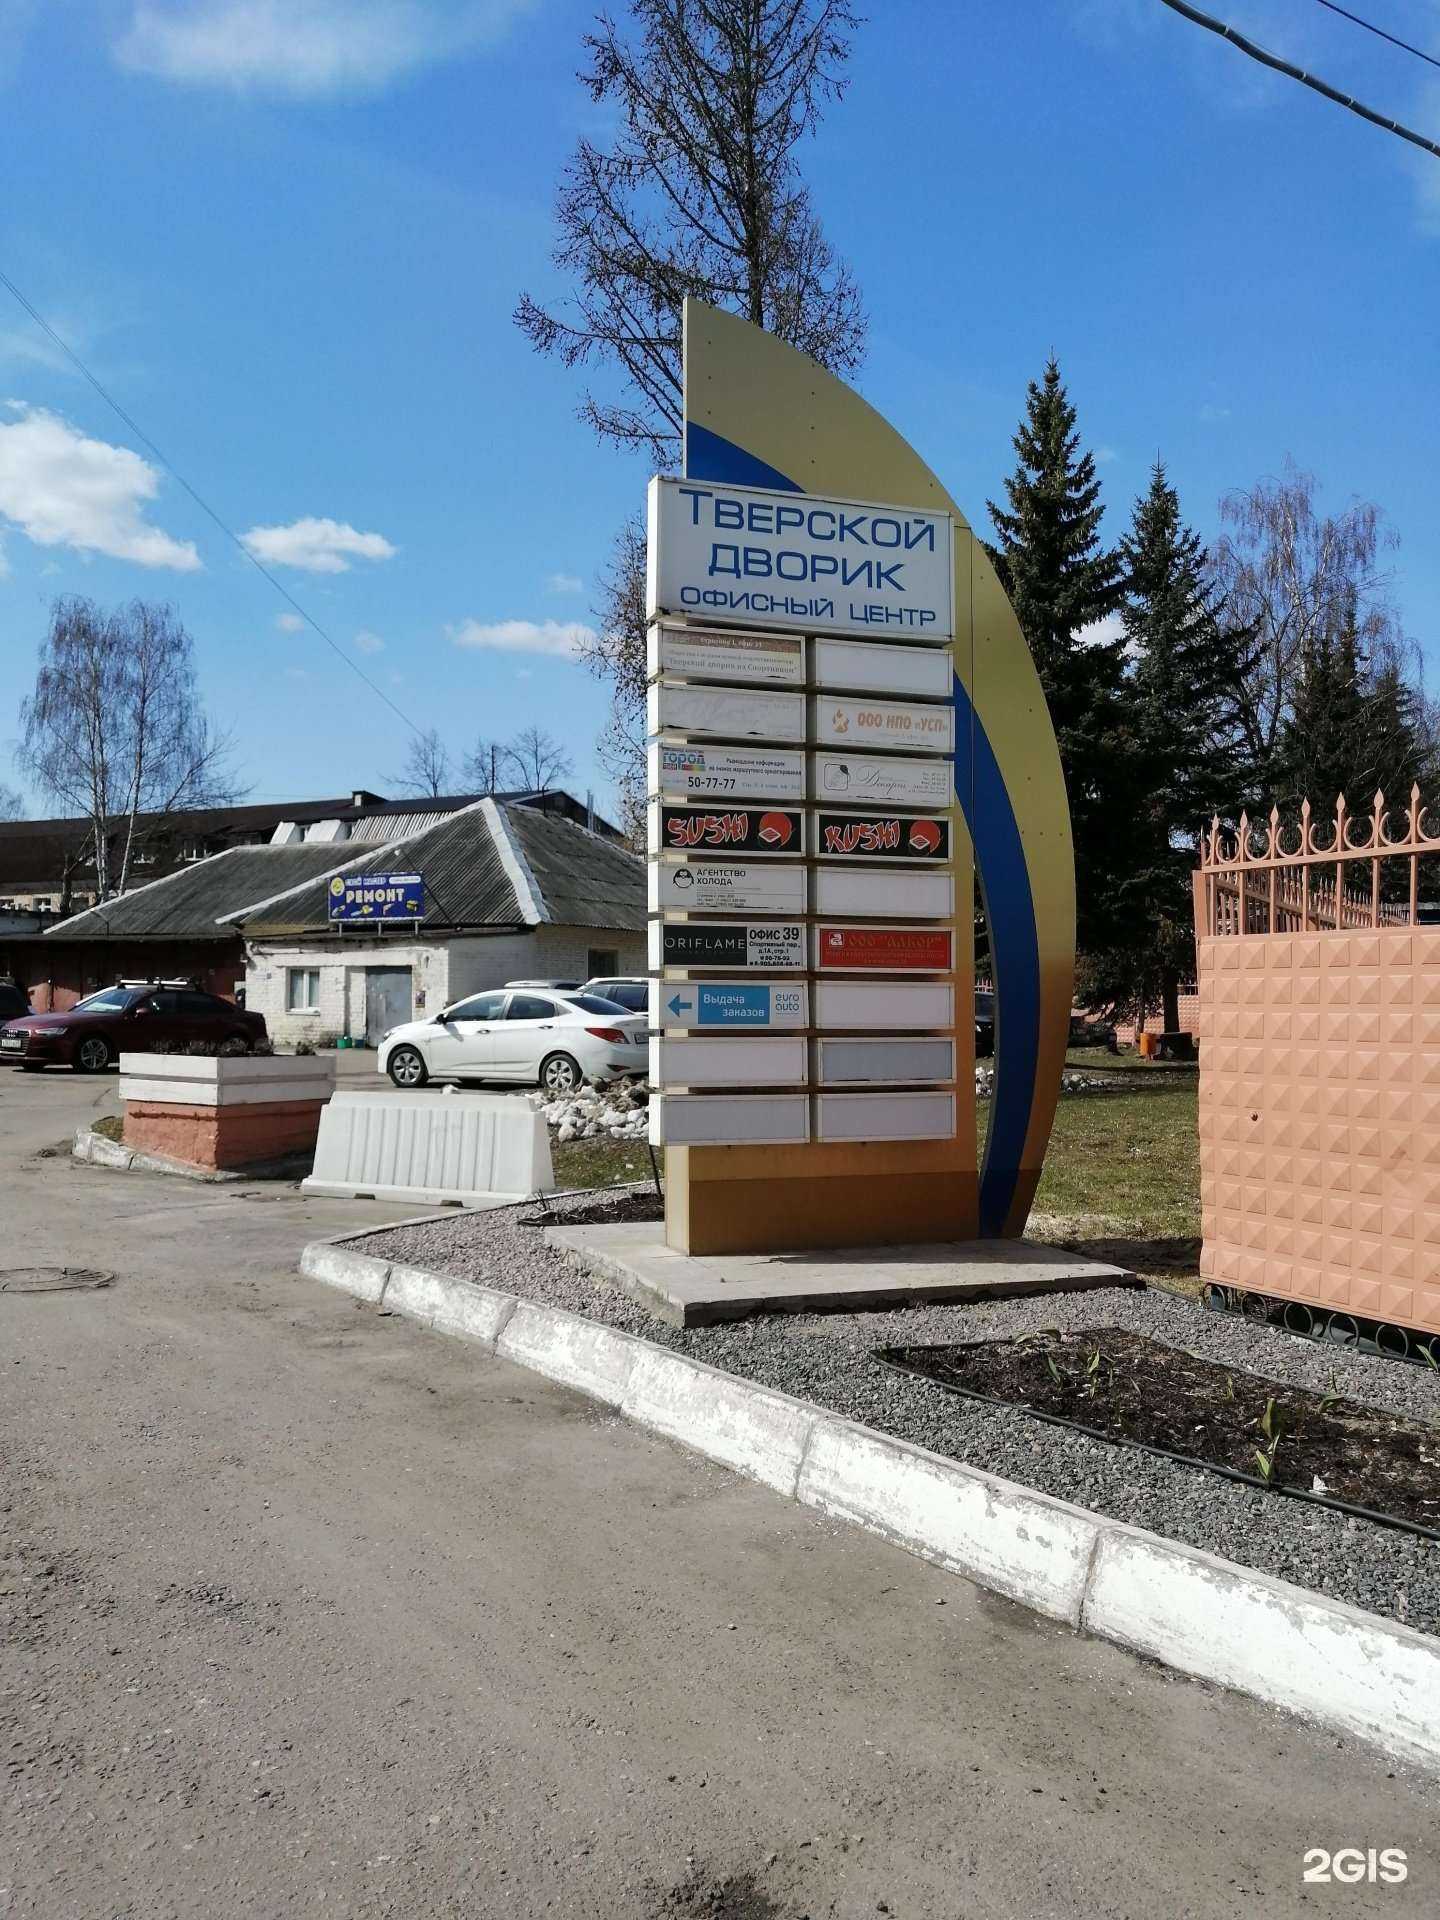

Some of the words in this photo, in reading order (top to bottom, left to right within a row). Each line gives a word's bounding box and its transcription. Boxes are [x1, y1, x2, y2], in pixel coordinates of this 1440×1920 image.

[679, 488, 935, 551] ТВЕРСКОЙ
[708, 543, 906, 591] ДВОРИК
[680, 586, 834, 618] ОФИСНЫЙ
[850, 603, 936, 626] ЦЕНТР
[857, 711, 882, 727] ООО
[886, 714, 912, 730] НПО
[687, 776, 736, 790] 50-77-77
[668, 812, 748, 847] SUSHI
[824, 820, 900, 853] KUSHI
[696, 869, 747, 878] АГЕНТСТВО
[696, 877, 733, 886] ХОЛОДА
[345, 888, 405, 903] РЕМОНТ
[750, 929, 780, 940] ОФИС
[783, 927, 799, 940] 39
[664, 937, 746, 949] ORIFLAME
[848, 935, 876, 947] ООО
[703, 993, 745, 1006] Выдача
[775, 992, 800, 1002] euro
[722, 1008, 765, 1017] заказов
[775, 1002, 800, 1011] auto
